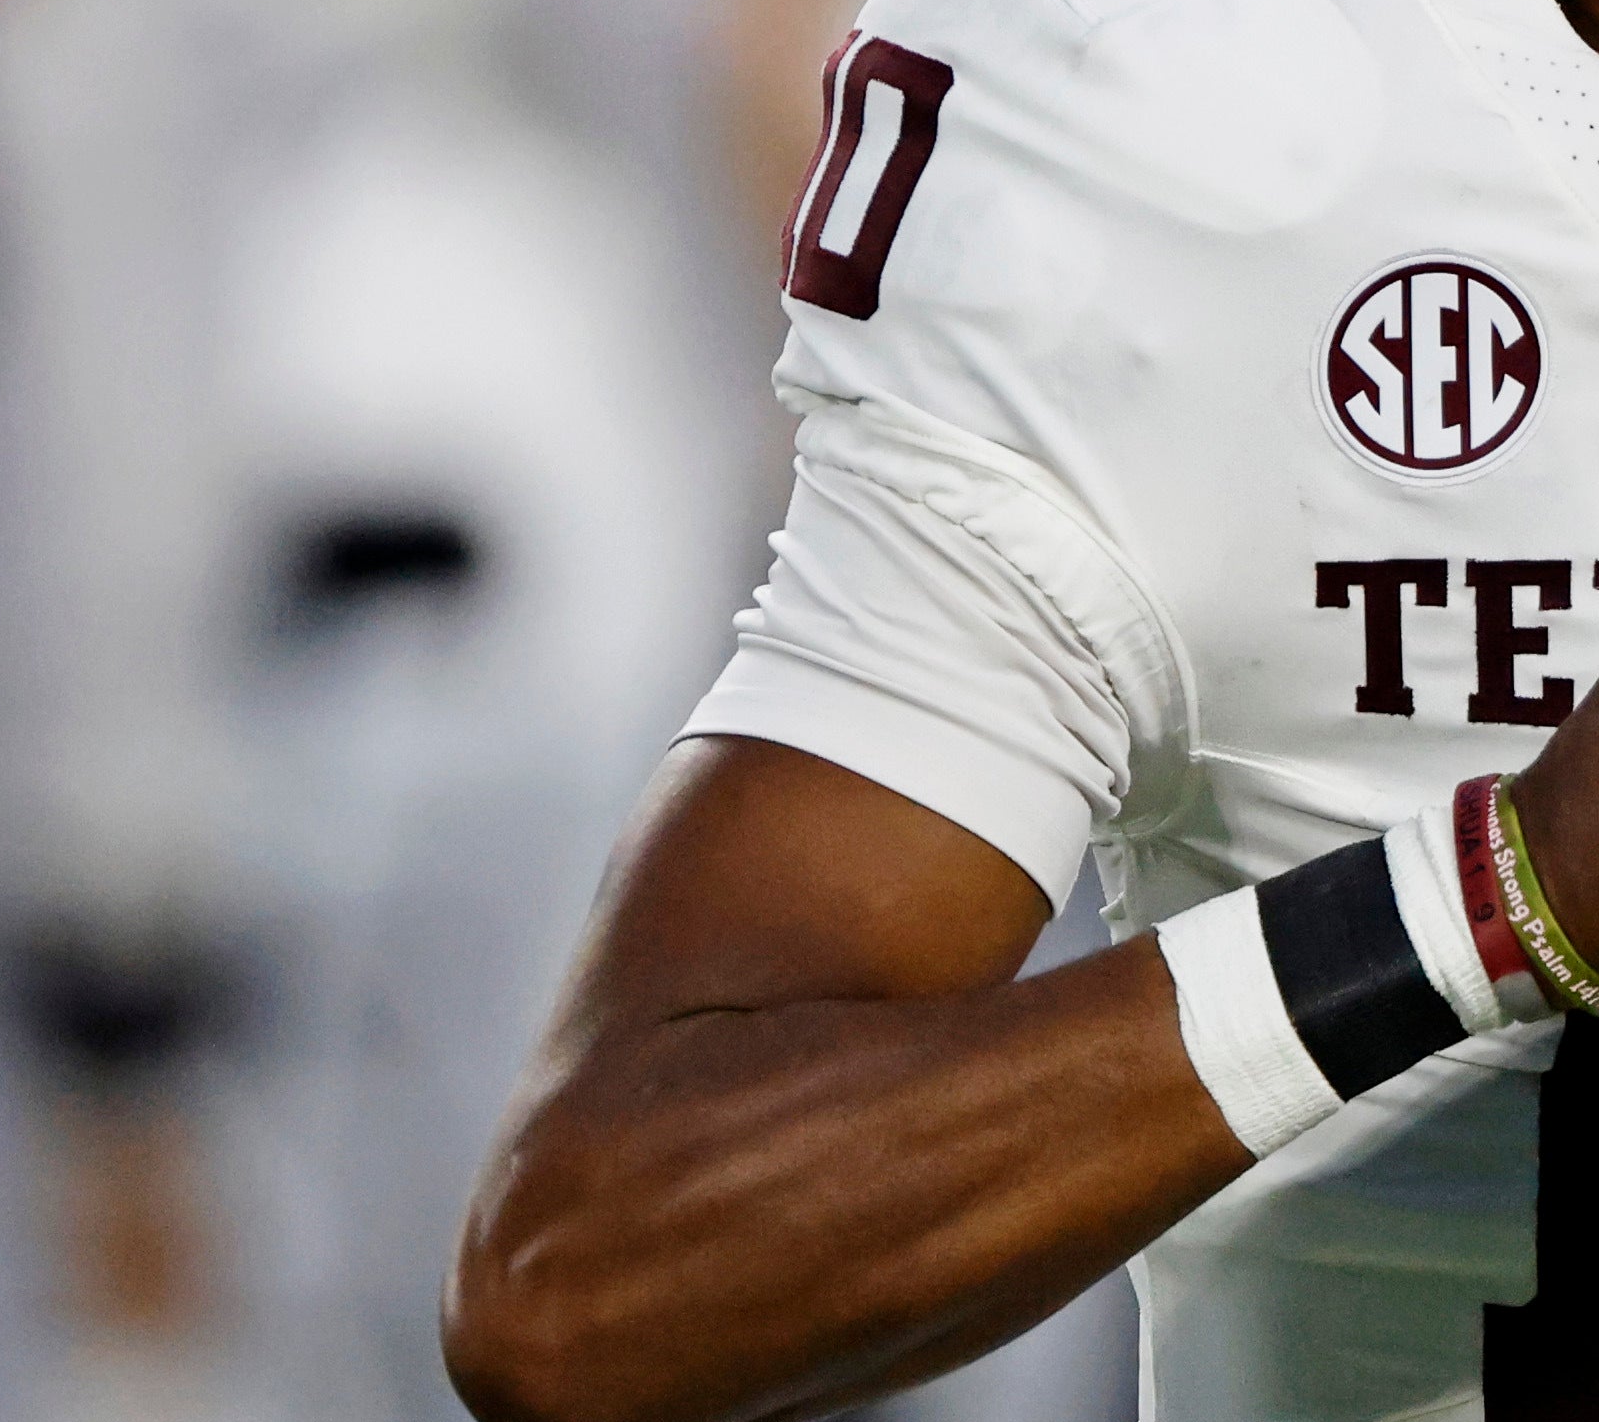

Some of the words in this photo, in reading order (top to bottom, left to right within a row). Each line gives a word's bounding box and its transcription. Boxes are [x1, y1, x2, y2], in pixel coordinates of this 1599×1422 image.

[779, 29, 955, 321] 0
[1340, 272, 1526, 460] SEC
[1494, 846, 1531, 923] Strong
[1521, 917, 1573, 985] Psalm
